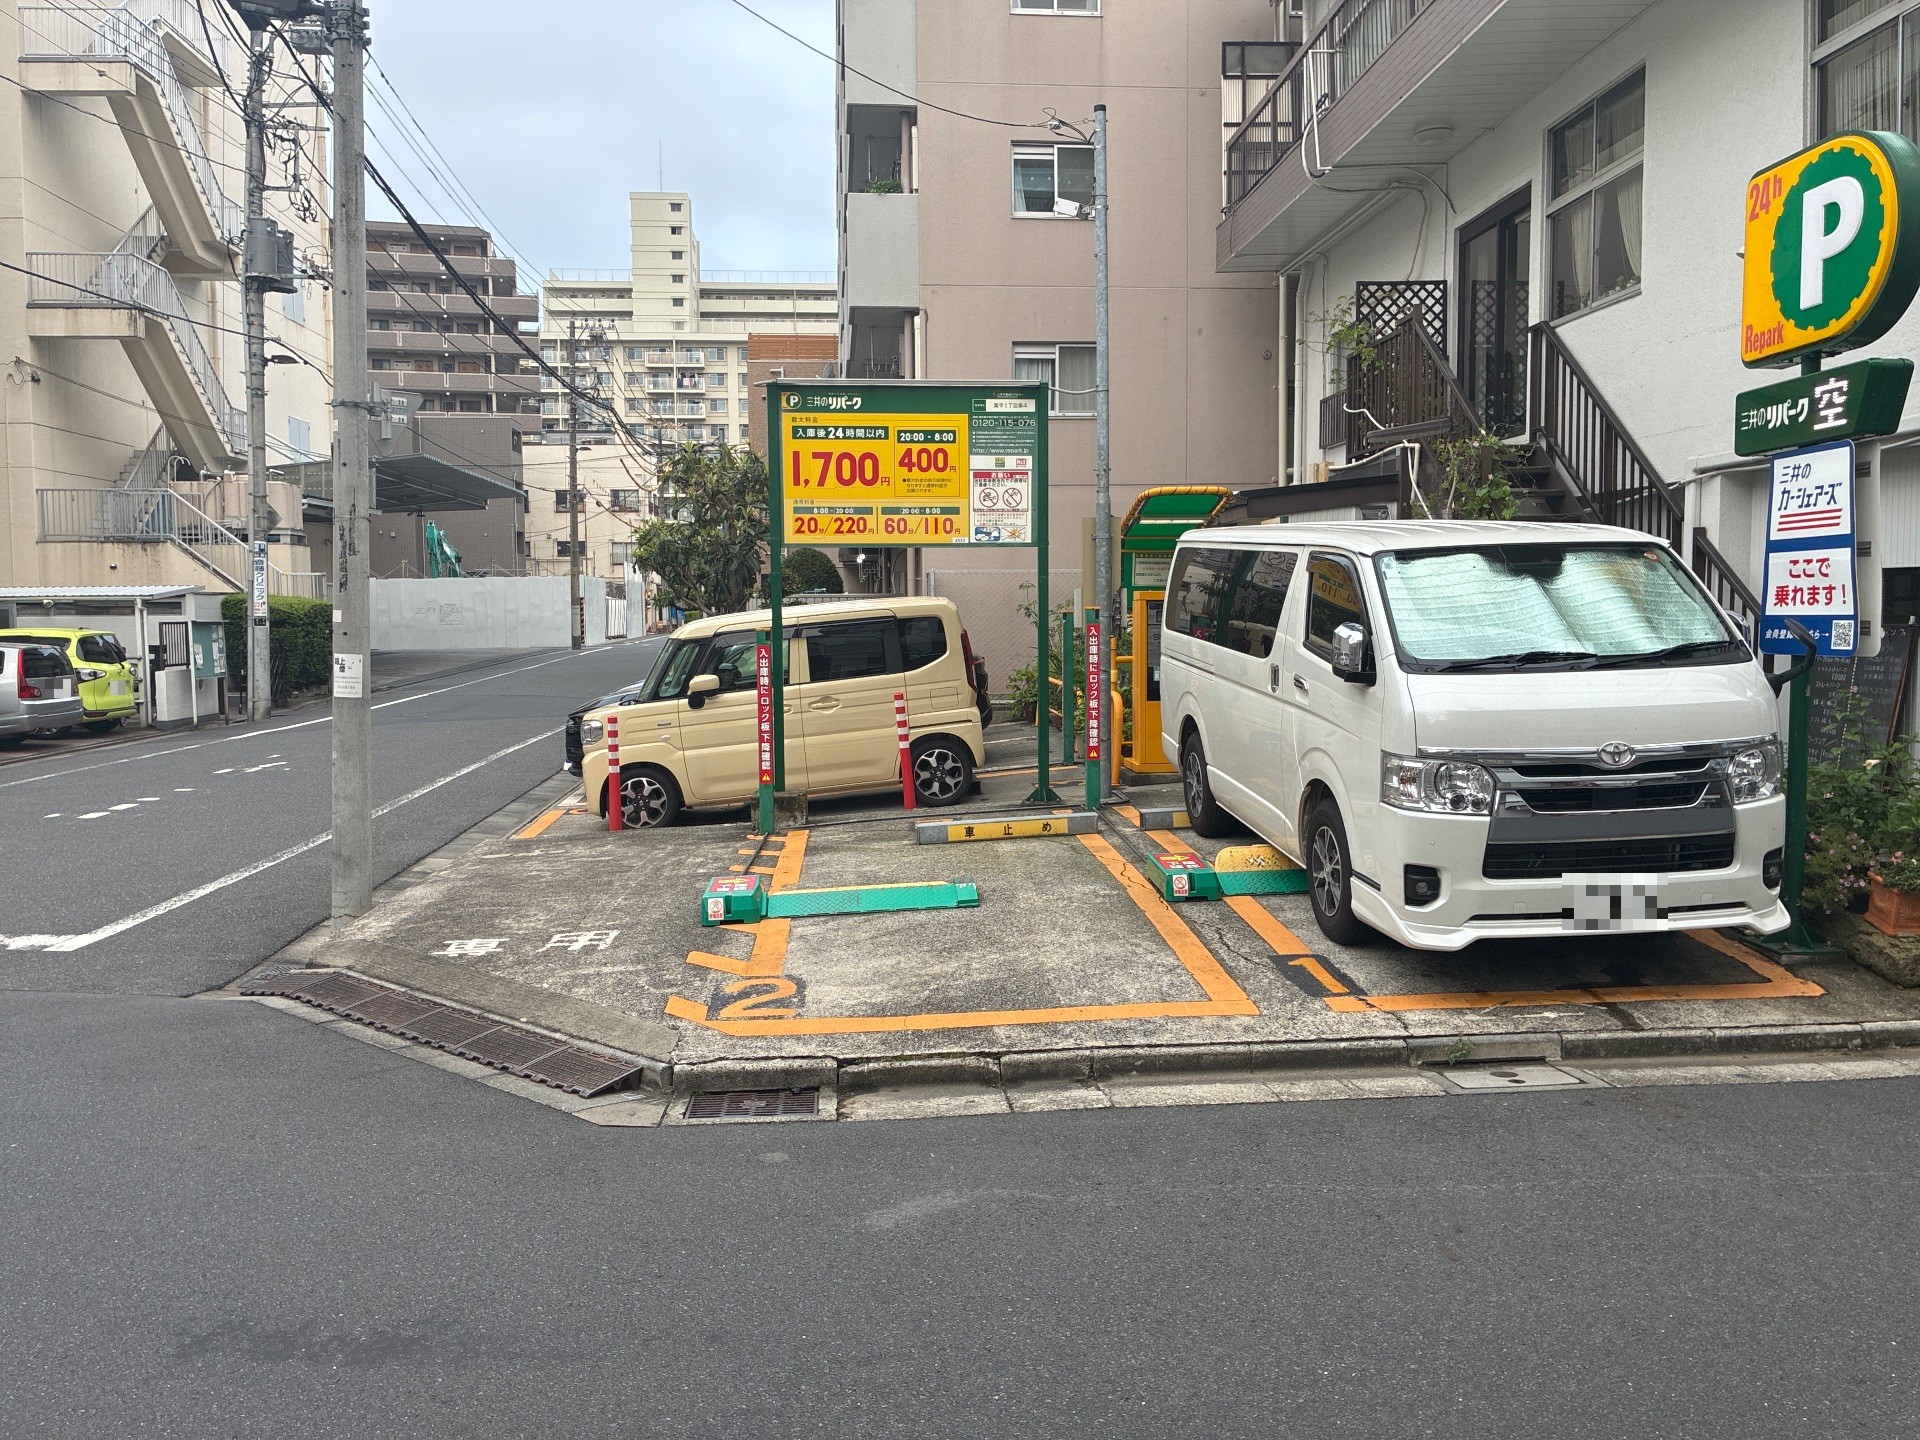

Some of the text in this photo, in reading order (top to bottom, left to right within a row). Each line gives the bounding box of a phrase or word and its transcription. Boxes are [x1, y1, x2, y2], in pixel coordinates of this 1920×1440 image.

[1748, 173, 1783, 223] 24h
[1799, 175, 1865, 311] P
[1744, 320, 1784, 355] Repark
[789, 395, 799, 407] P
[806, 395, 862, 410] 三井のリパーク
[1740, 397, 1809, 431] 三井のリパーク
[1813, 376, 1850, 431] 空
[796, 426, 885, 439] 入庫後24時間以内
[899, 432, 924, 441] 20:00
[934, 432, 954, 441] 8:00
[972, 419, 1036, 427] 0120-115-076
[792, 450, 890, 488] 1,700円
[898, 447, 957, 473] 400円
[1779, 462, 1811, 484] 三井の
[1777, 481, 1843, 512] カーシェアーズ
[1788, 557, 1830, 579] ここで
[963, 821, 1052, 838] 車止め
[1287, 957, 1350, 994] 1
[718, 977, 798, 1018] 2
